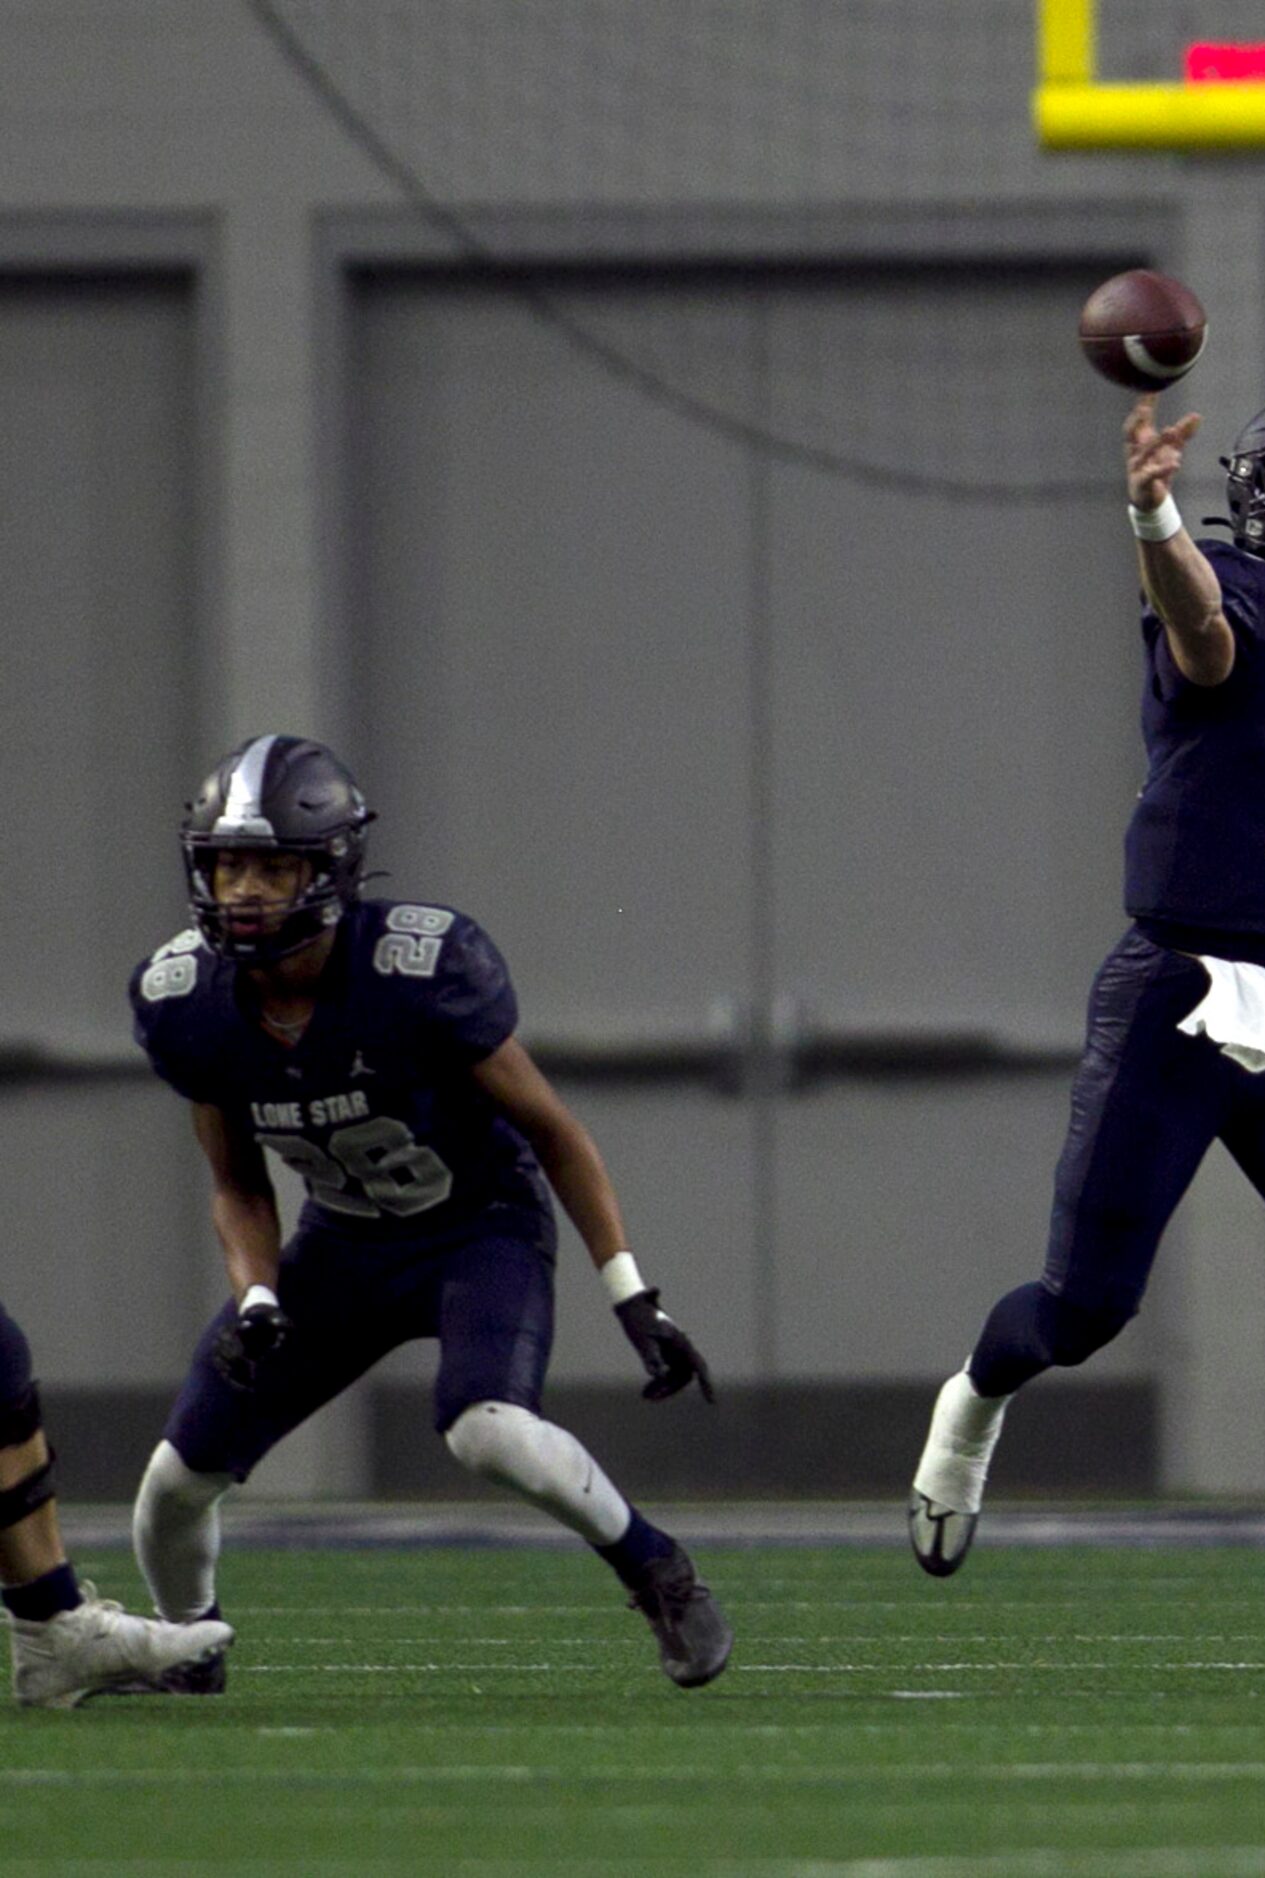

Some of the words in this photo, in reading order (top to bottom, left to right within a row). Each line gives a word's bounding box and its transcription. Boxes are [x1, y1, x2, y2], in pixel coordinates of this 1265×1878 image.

[374, 905, 455, 977] 28
[252, 1103, 304, 1129] LONE
[310, 1091, 369, 1126] STAR
